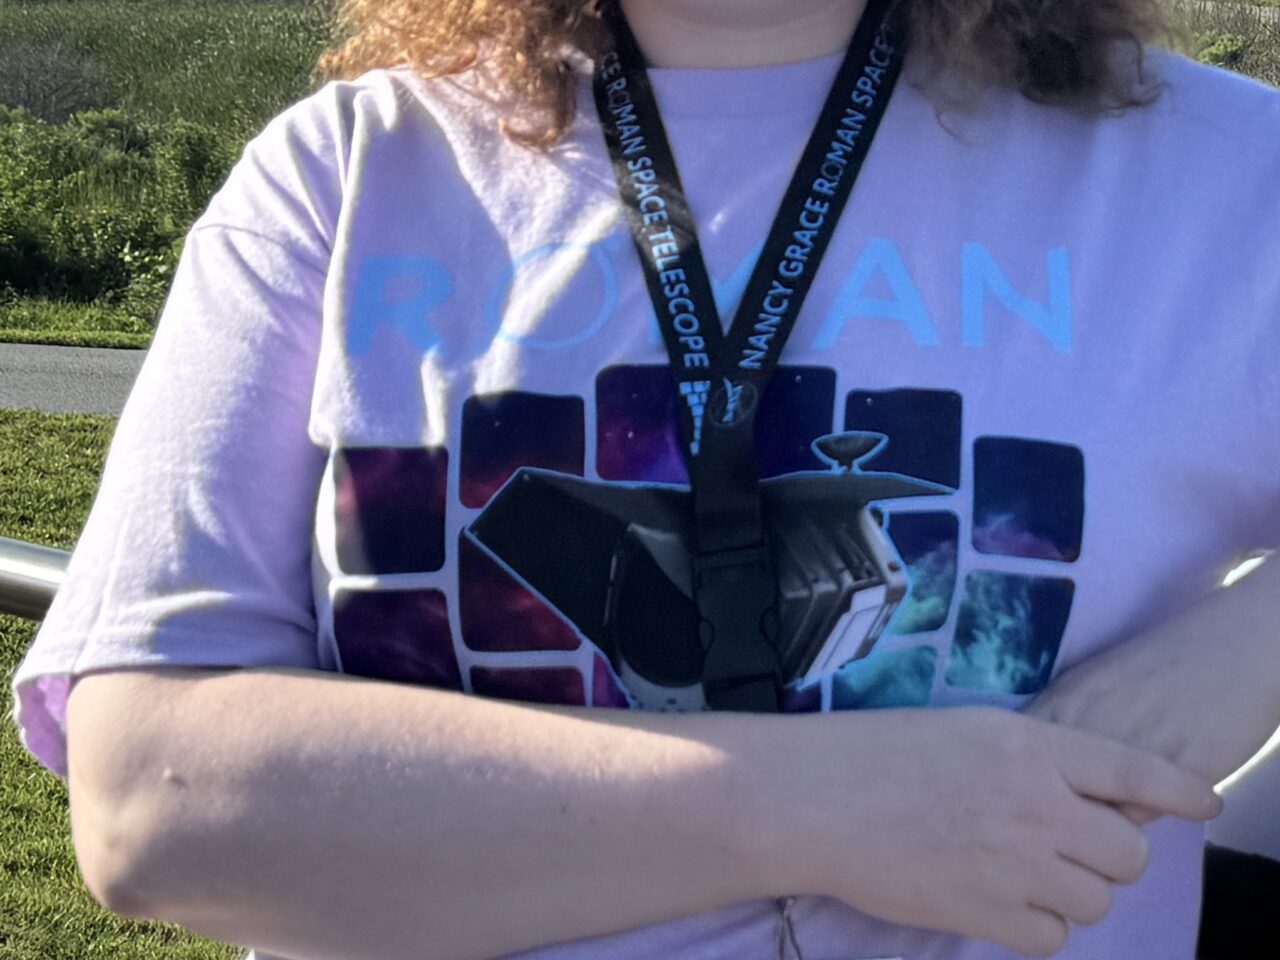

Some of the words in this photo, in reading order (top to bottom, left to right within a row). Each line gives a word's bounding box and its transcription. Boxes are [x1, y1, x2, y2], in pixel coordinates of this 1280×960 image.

[606, 77, 646, 156] ROMAN
[627, 156, 668, 225] SPACE
[649, 225, 710, 368] TELESCOPE
[738, 280, 794, 369] NANCY
[778, 197, 830, 279] GRACE
[813, 108, 866, 194] ROMAN
[852, 36, 894, 108] SPACE
